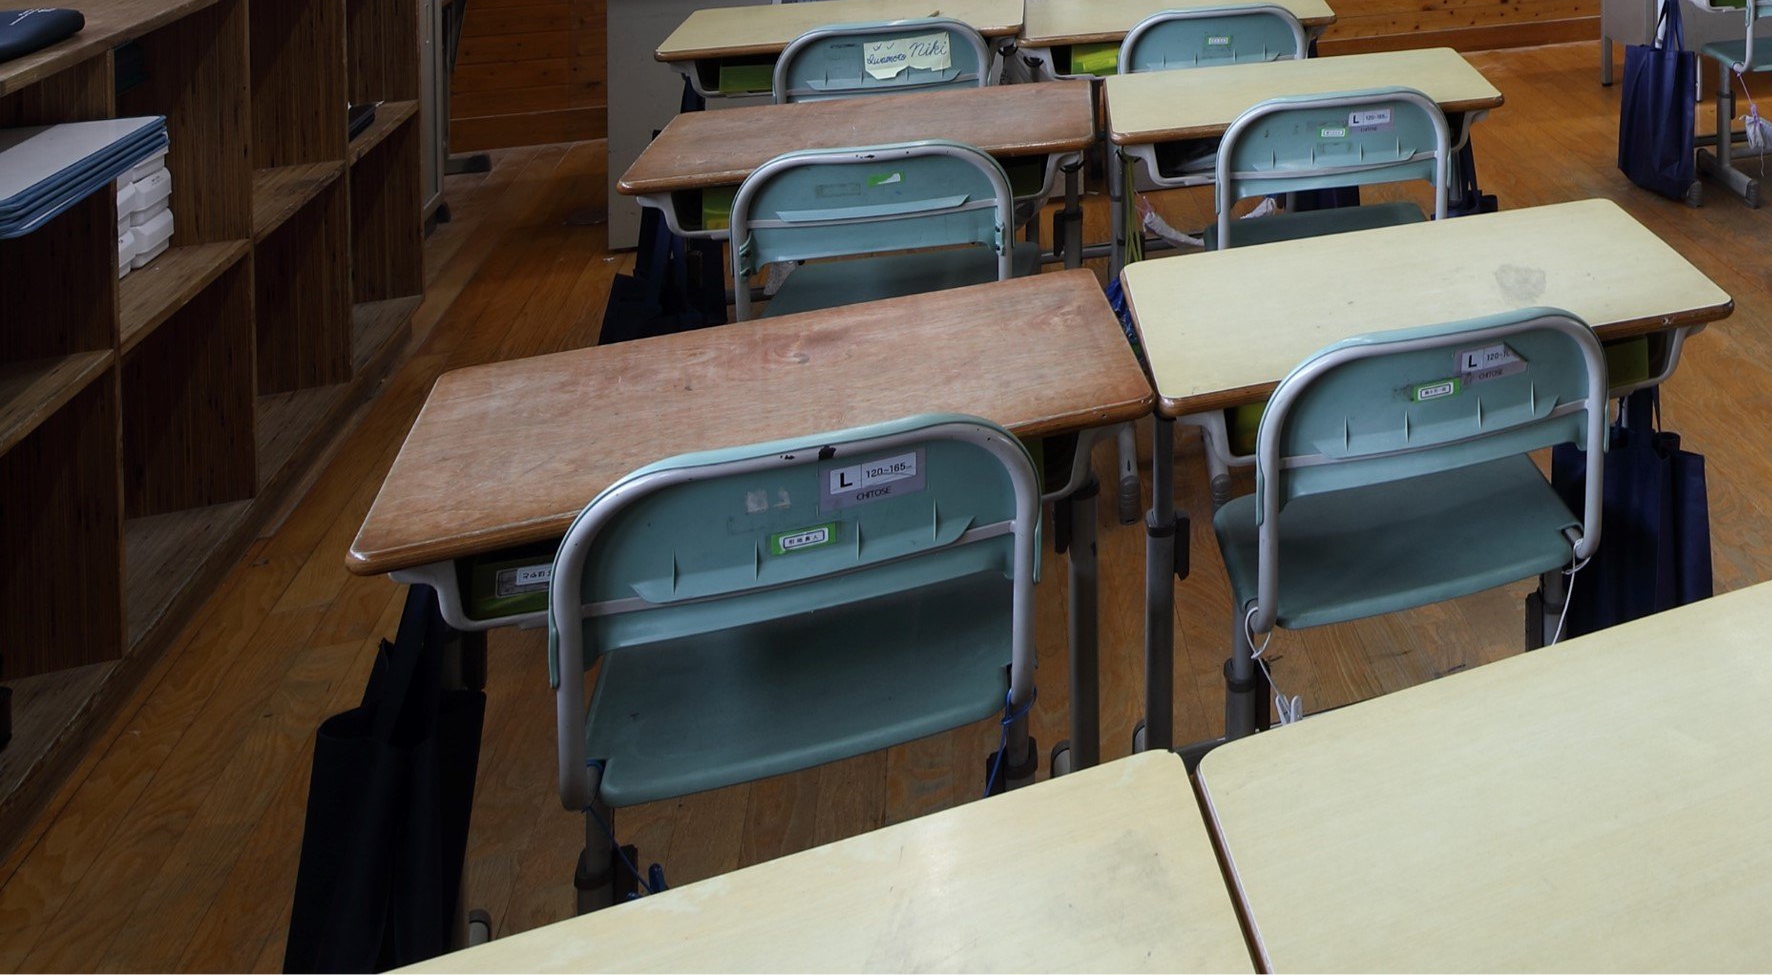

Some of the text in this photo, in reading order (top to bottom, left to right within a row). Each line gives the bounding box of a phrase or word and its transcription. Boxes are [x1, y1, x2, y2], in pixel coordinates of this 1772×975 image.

[909, 40, 948, 58] Niki
[1353, 115, 1360, 124] L
[1468, 355, 1478, 368] L
[839, 472, 853, 488] L
[856, 485, 892, 501] CHITOSE
